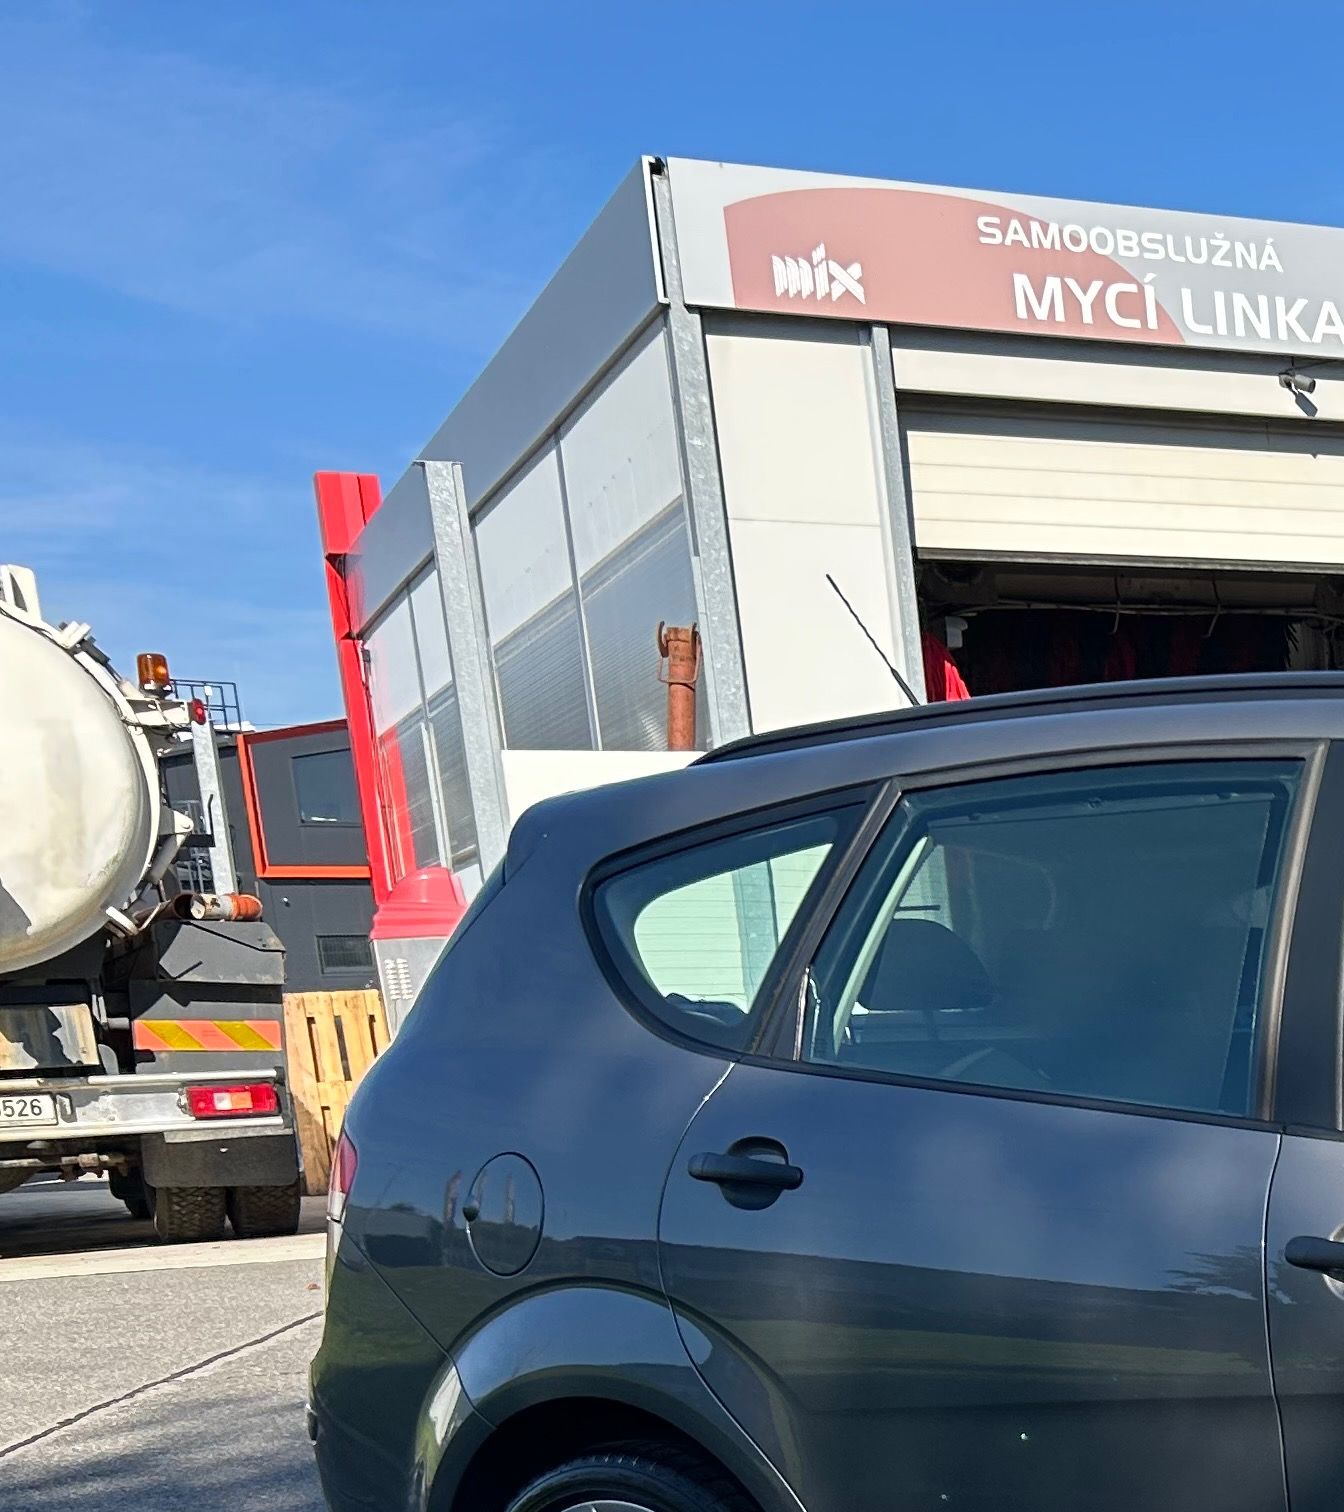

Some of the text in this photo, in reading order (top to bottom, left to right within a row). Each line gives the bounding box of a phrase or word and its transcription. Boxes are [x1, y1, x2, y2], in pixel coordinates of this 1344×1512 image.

[976, 215, 1284, 273] SAMOOBSLUŽNÁ
[1012, 272, 1160, 330] MYCÍ
[0, 1098, 43, 1118] 526
